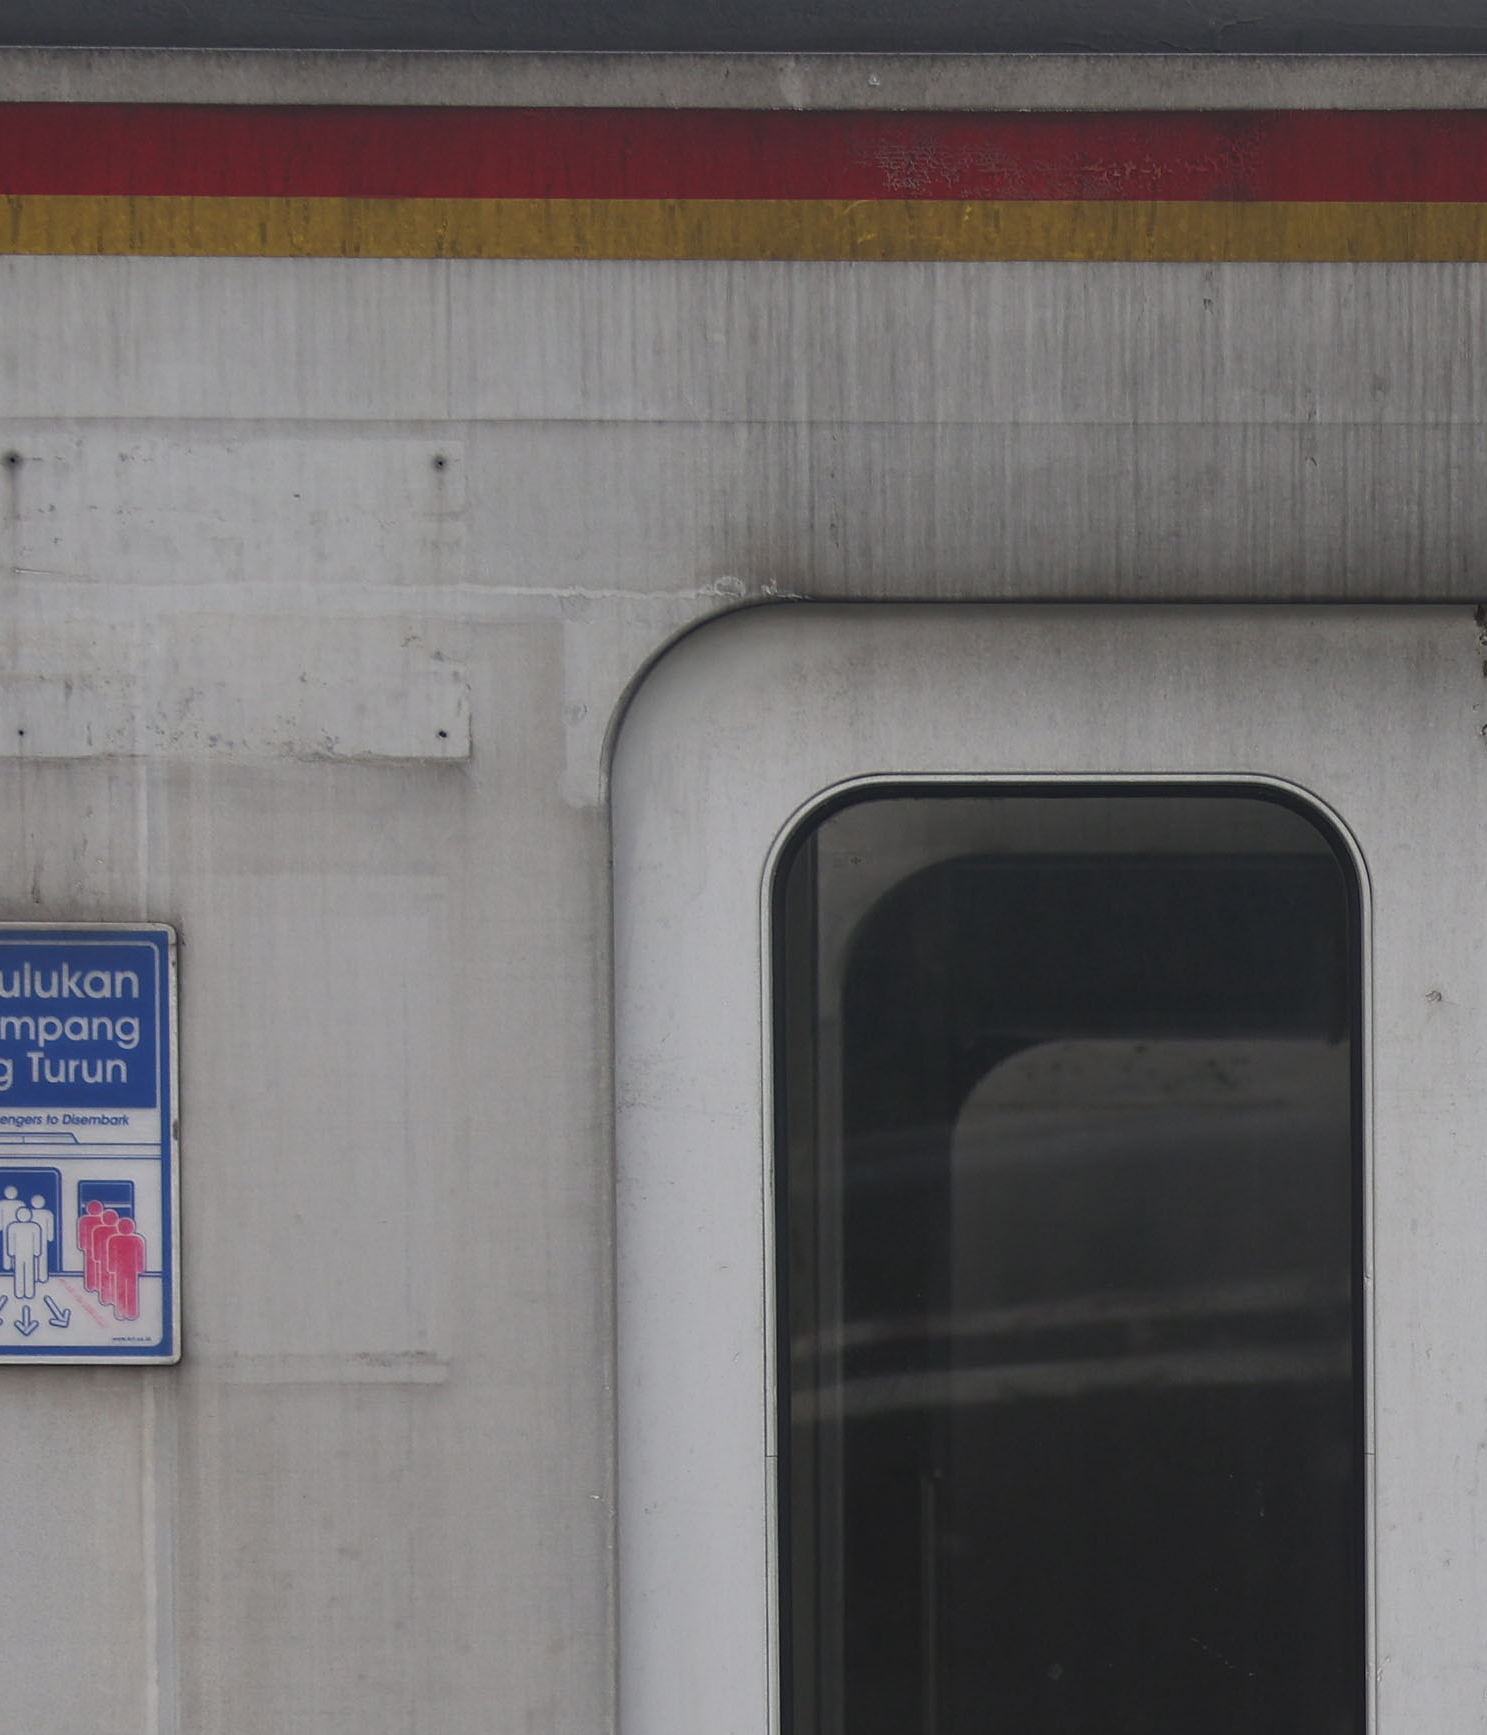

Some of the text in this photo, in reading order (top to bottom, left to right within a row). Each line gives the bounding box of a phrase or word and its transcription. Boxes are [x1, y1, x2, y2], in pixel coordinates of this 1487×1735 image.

[27, 1052, 127, 1084] Turun
[46, 1114, 59, 1125] to
[62, 1113, 129, 1126] Disembark
